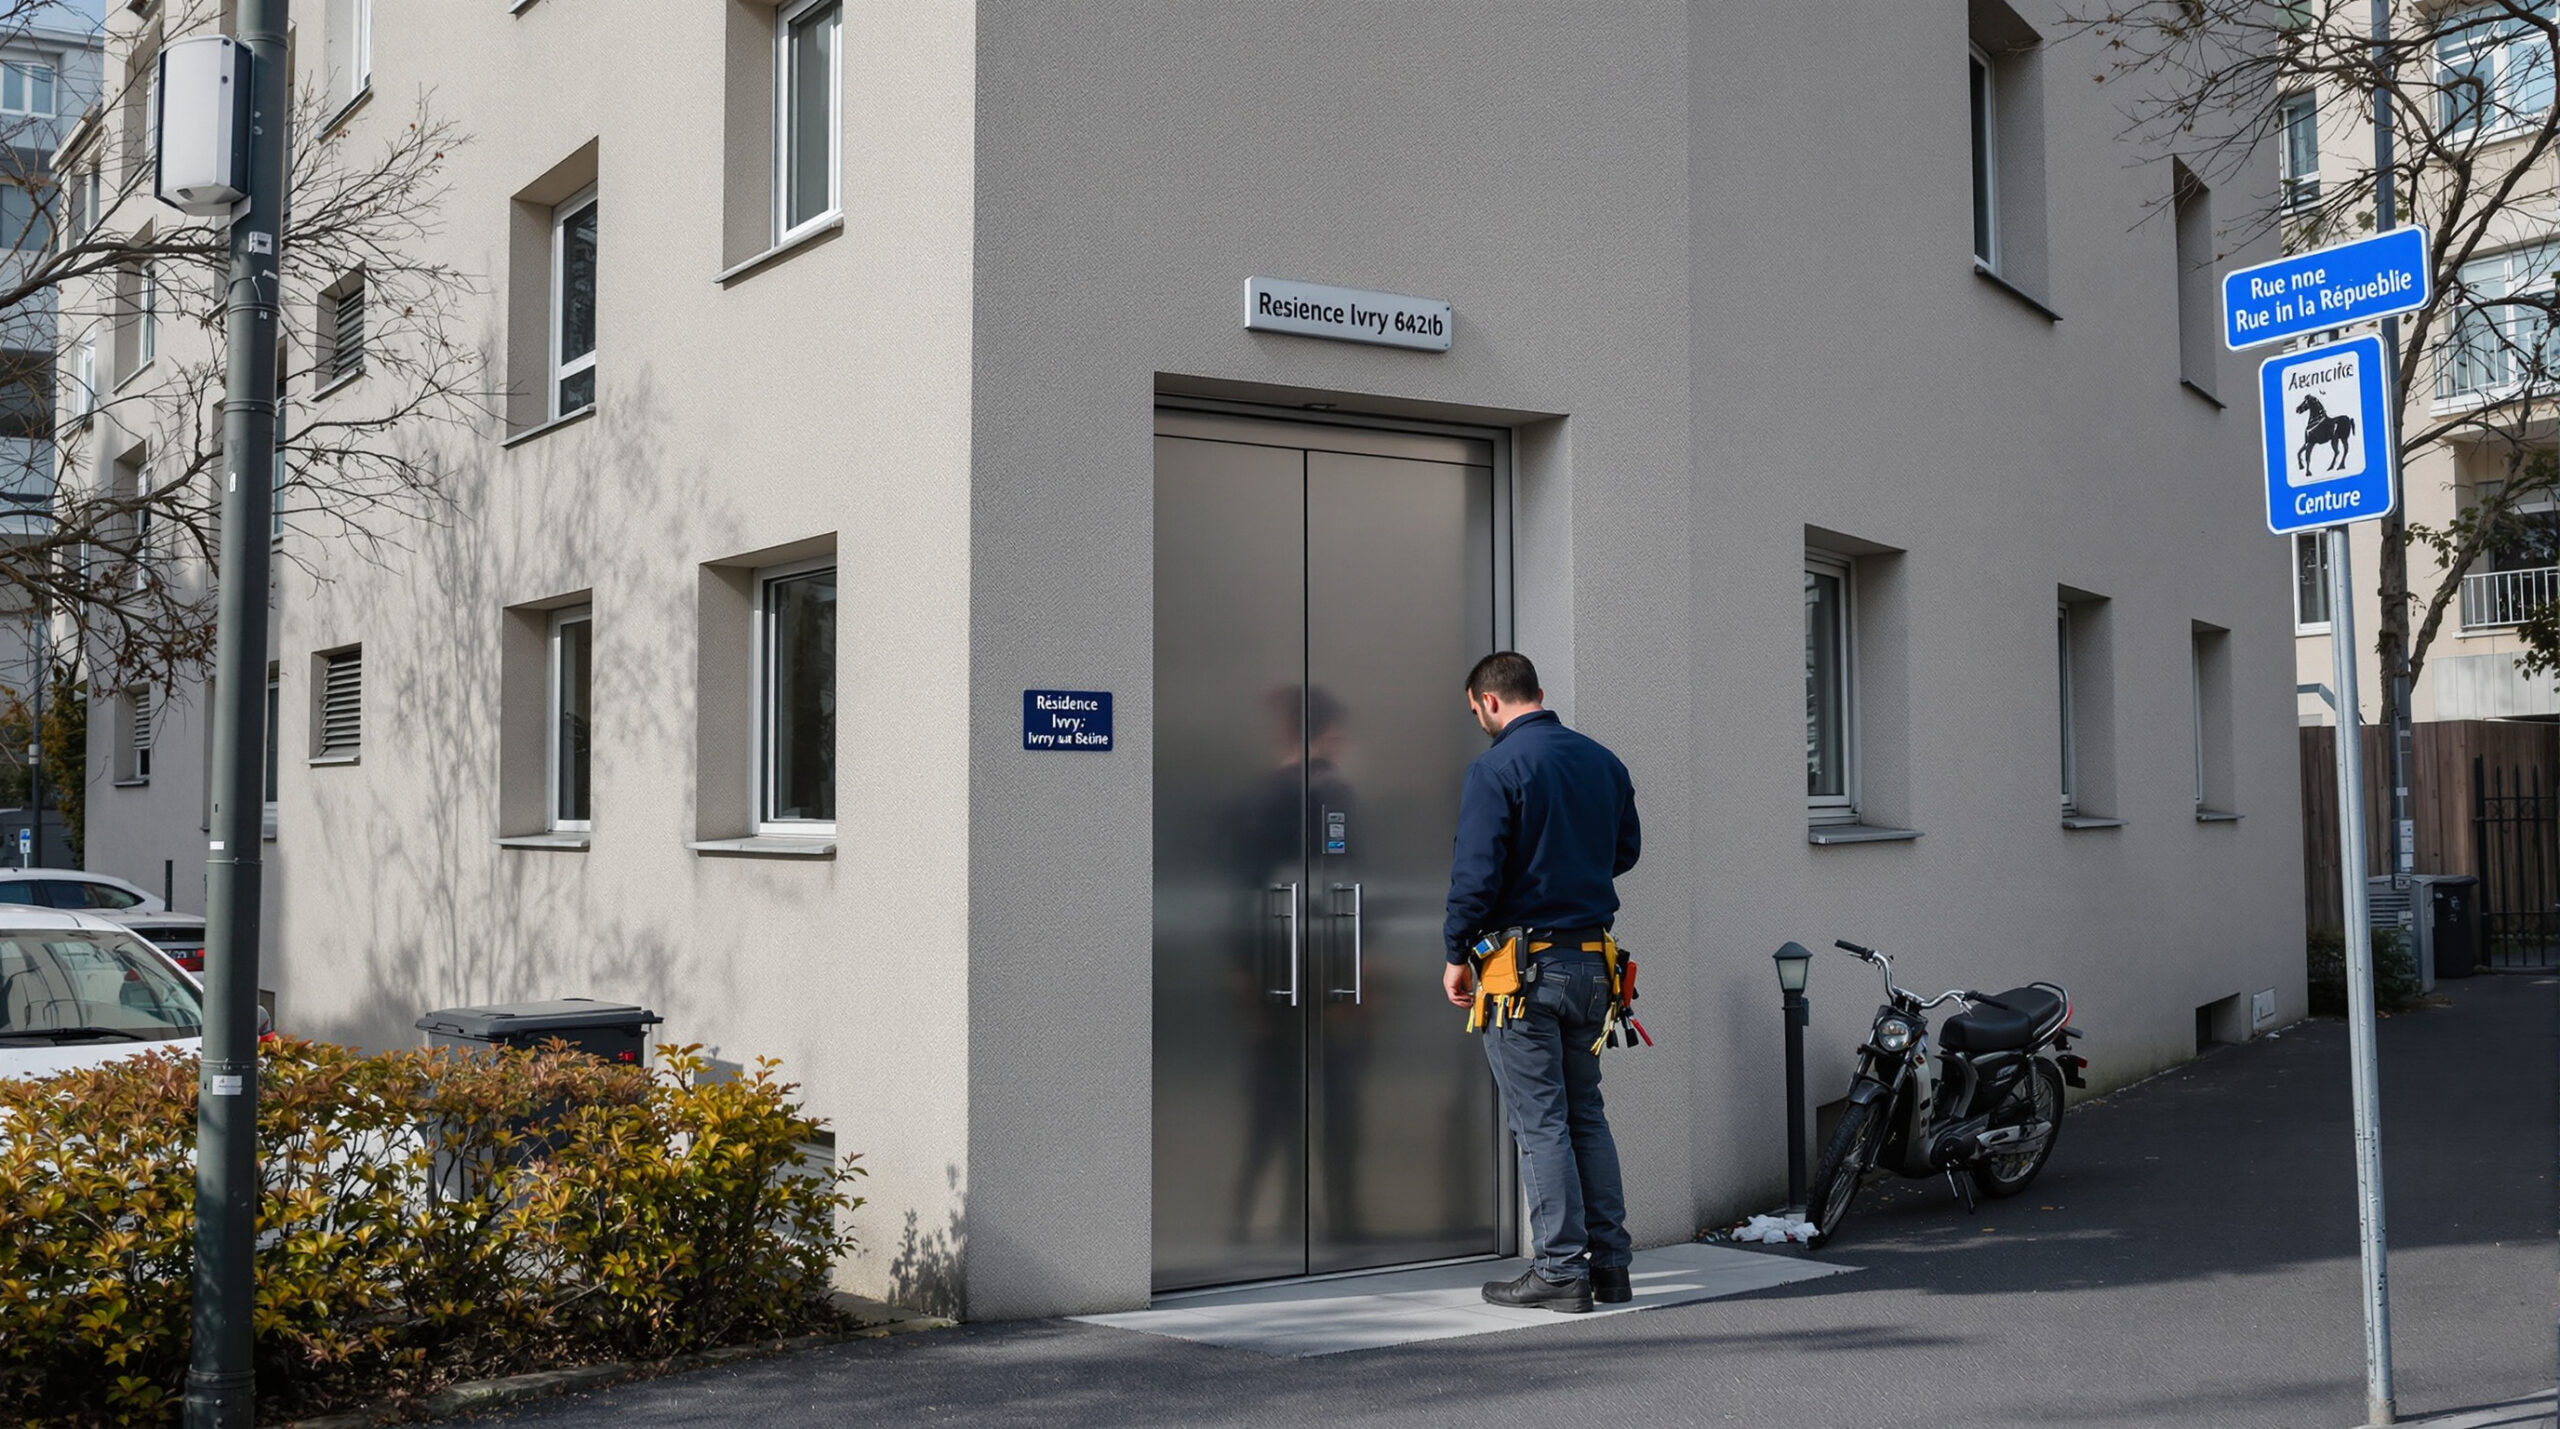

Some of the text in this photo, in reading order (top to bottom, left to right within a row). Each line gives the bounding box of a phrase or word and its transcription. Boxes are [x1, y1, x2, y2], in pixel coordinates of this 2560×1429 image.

[2251, 277, 2286, 299] Rue
[1259, 292, 1344, 324] Resience
[1351, 304, 1389, 335] Ivry
[2235, 309, 2270, 332] Rue
[2275, 301, 2293, 323] in
[2298, 295, 2316, 317] la
[2295, 489, 2361, 516] Centure
[1037, 694, 1098, 711] Résidence
